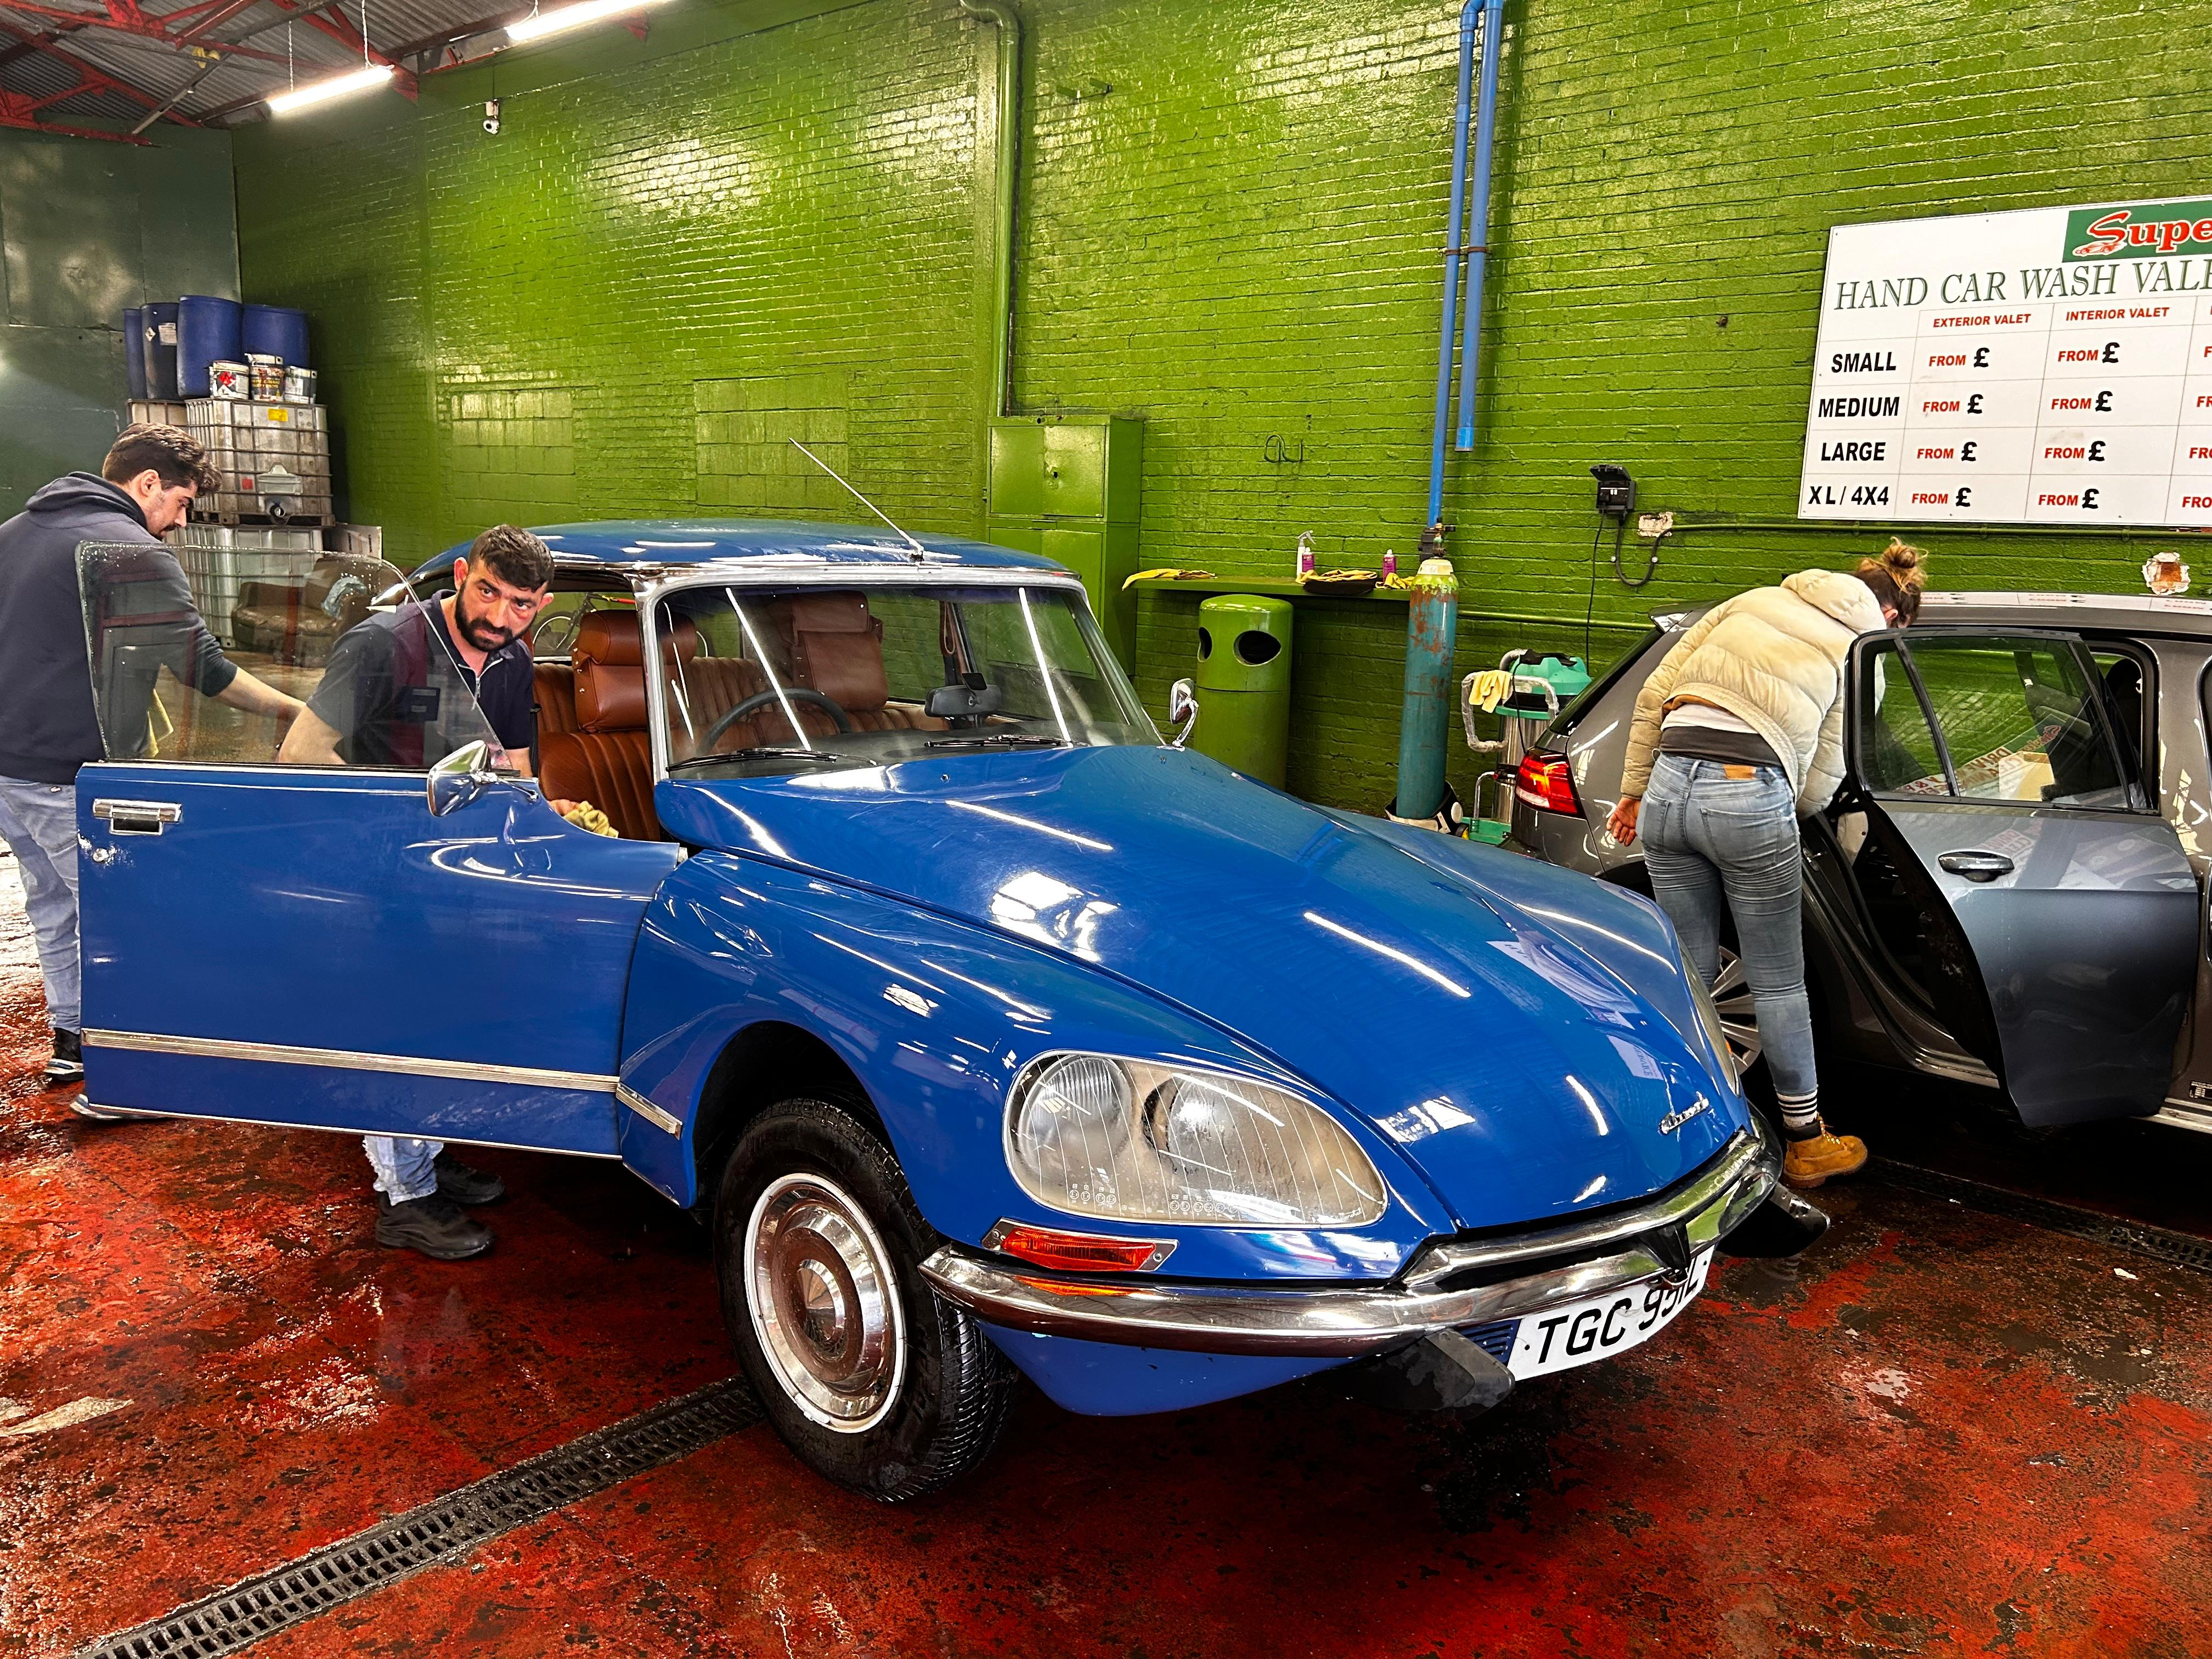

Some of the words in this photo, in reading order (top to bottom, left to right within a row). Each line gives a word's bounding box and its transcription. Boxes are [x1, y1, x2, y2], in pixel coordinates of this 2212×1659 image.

[2087, 210, 2212, 253] Supe
[1833, 277, 1928, 310] HAND
[1942, 272, 2006, 304] CAR
[2019, 261, 2120, 299] WASH
[1933, 315, 1990, 328] EXTERIOR
[1994, 313, 2031, 324] VALET
[2066, 309, 2125, 320] INTERIOR
[2130, 307, 2169, 317] VALET
[1831, 352, 1897, 373] SMALL
[1929, 355, 1966, 366] FROM
[1973, 347, 1990, 368] £
[2058, 350, 2098, 361] FROM
[2102, 342, 2120, 363] £
[1818, 396, 1900, 417] MEDIUM
[1923, 401, 1960, 413] FROM
[1967, 394, 1984, 414] £
[2051, 398, 2091, 409] FROM
[2095, 391, 2113, 412] £
[1821, 442, 1886, 461] LARGE
[1917, 448, 1954, 459] FROM
[1961, 441, 1977, 462] £
[2045, 447, 2085, 459] FROM
[2088, 441, 2106, 462] £
[2190, 447, 2212, 459] FR
[1912, 493, 1949, 504] FROM
[1955, 487, 1972, 507] £
[2038, 494, 2079, 506] FROM
[2081, 488, 2100, 509] £
[1537, 1297, 1632, 1364] TGC
